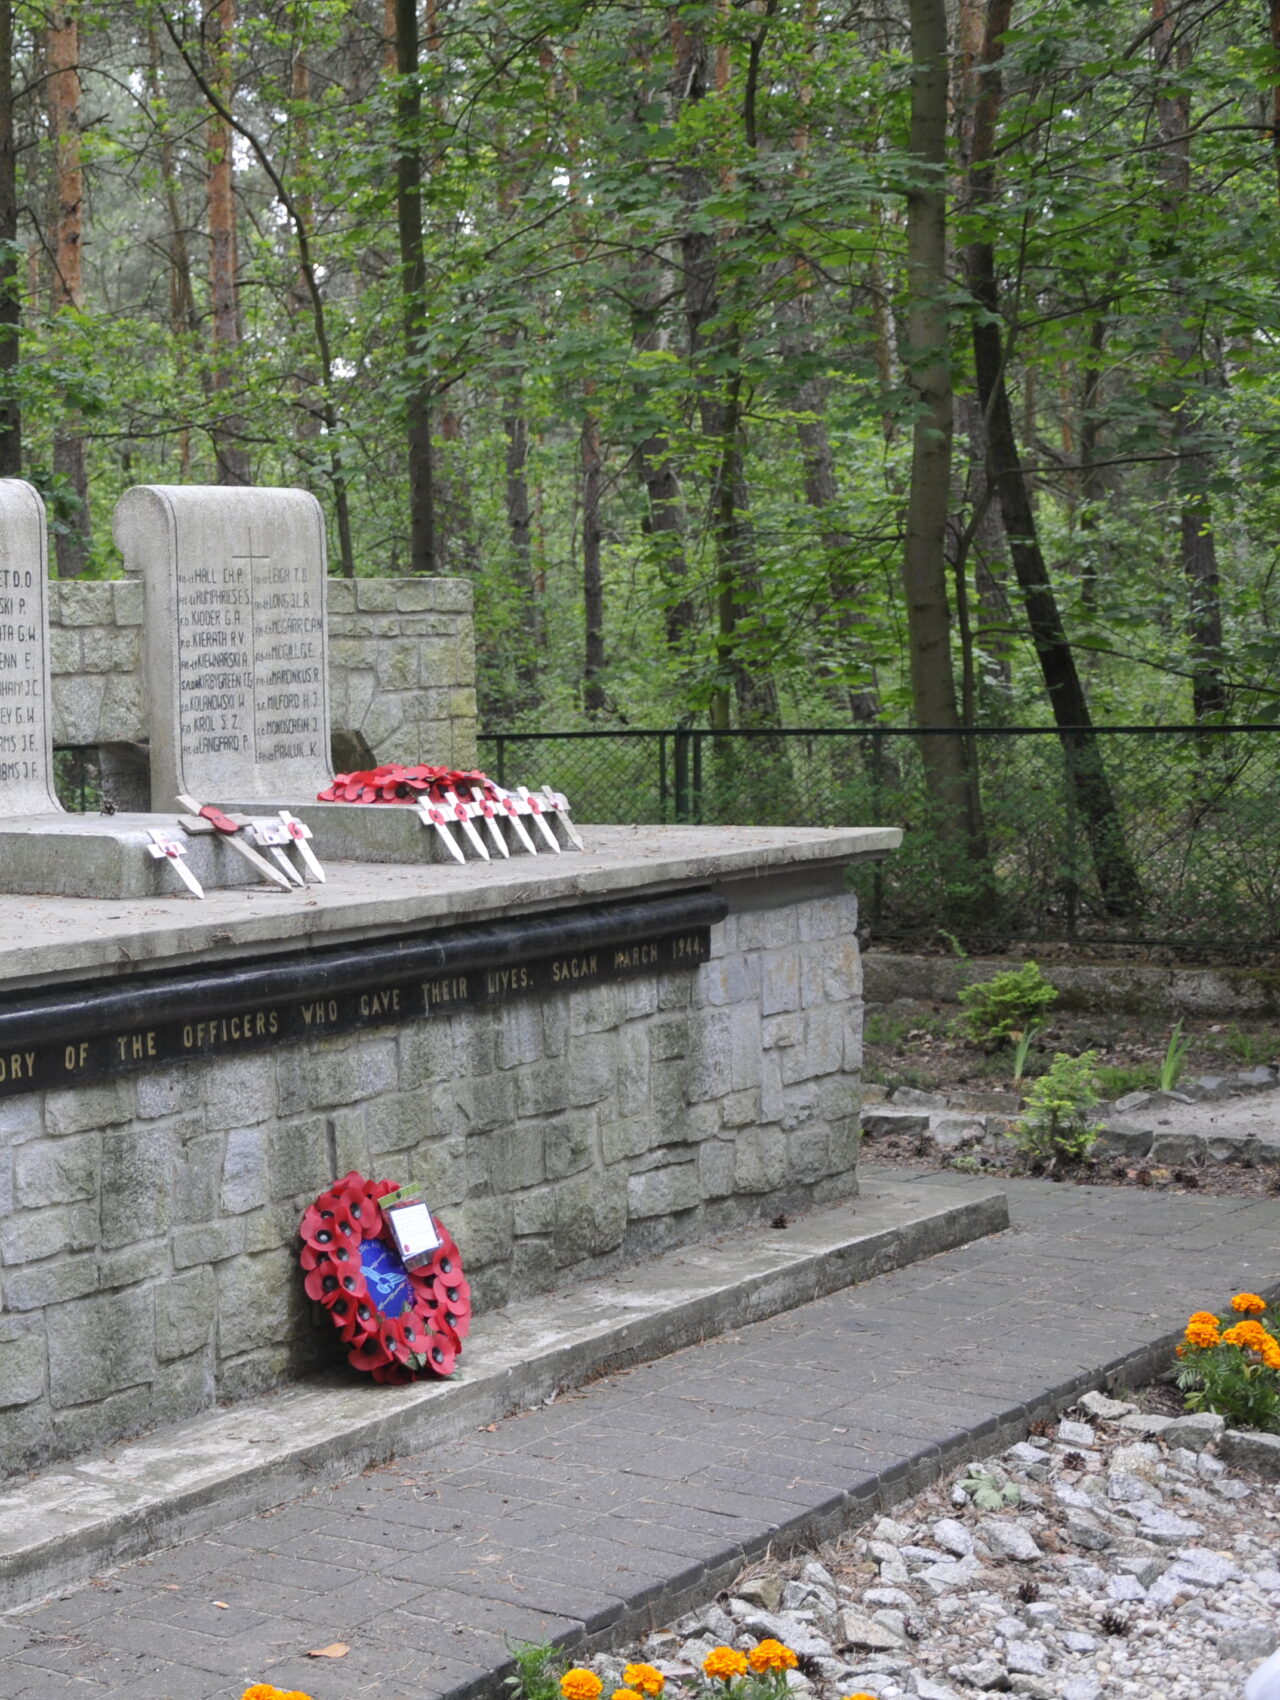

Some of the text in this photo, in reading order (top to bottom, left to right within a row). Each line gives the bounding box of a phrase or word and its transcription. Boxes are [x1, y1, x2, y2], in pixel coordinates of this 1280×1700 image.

[195, 567, 217, 584] HALL
[193, 631, 227, 648] KIERATH
[194, 716, 215, 732] KROL
[65, 1043, 89, 1070] OF
[118, 1032, 157, 1062] THE
[183, 1012, 279, 1048] OFFICERS
[302, 1002, 338, 1026] WHO
[360, 989, 401, 1017] GAVE
[422, 977, 468, 1004] THEIR
[488, 968, 535, 994] LIVES.
[552, 953, 598, 982] SAGAN
[614, 944, 658, 970] MARCH
